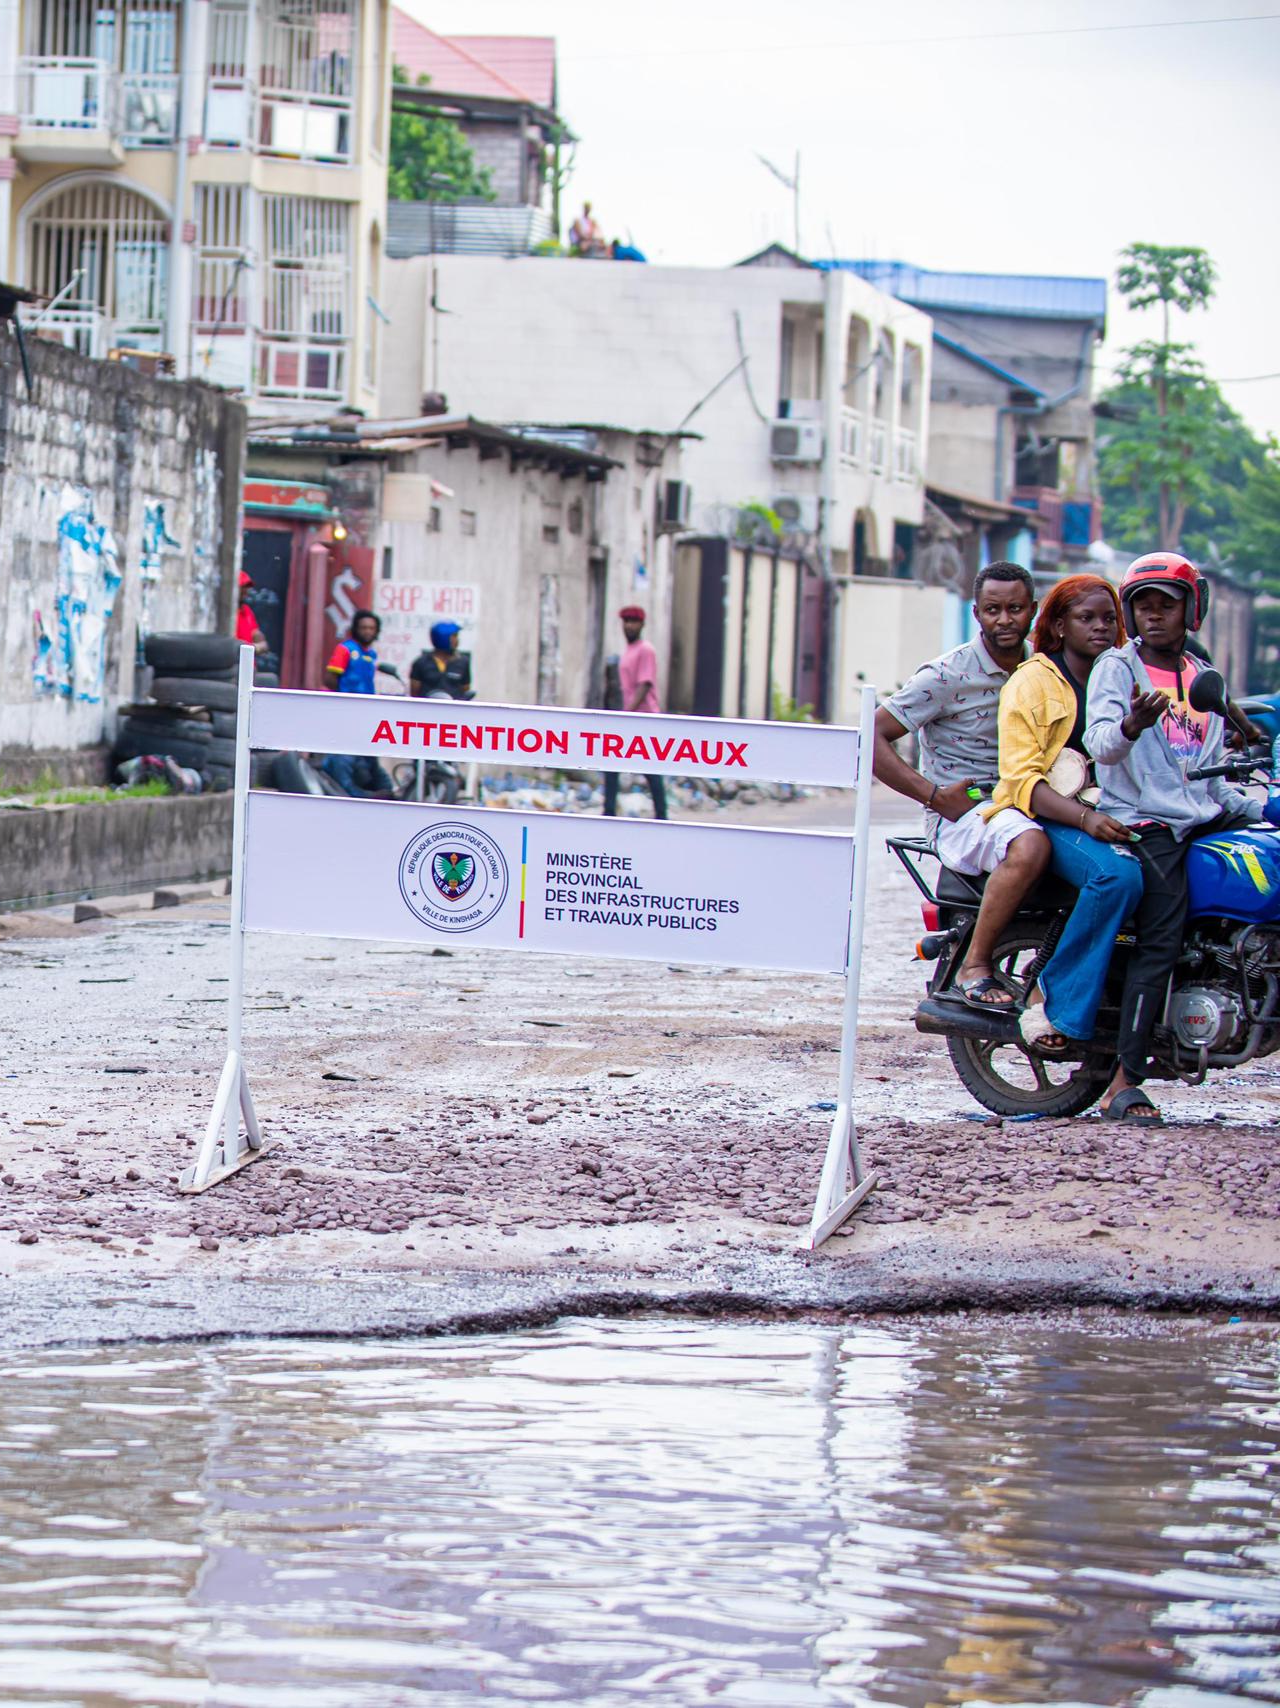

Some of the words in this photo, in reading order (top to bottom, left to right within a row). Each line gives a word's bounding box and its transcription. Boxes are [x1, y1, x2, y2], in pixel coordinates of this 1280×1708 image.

[370, 719, 569, 755] ATTENTION
[578, 731, 749, 769] TRAVAUX
[408, 837, 432, 874] RÉPUBLIQUE
[431, 831, 482, 848] DÉMOCRATIQUE
[487, 855, 499, 880] CONGO
[546, 852, 633, 871] MINISTÈRE
[545, 870, 644, 890] PROVINCIAL
[545, 888, 578, 904] DES
[581, 890, 740, 914] INFRASTRUCTURES
[422, 904, 438, 920] VILLE
[439, 914, 449, 923] DE
[449, 909, 484, 924] KINSHASA
[544, 907, 566, 922] ET
[569, 908, 644, 927] TRAVAUX
[647, 913, 718, 932] PUBLICS
